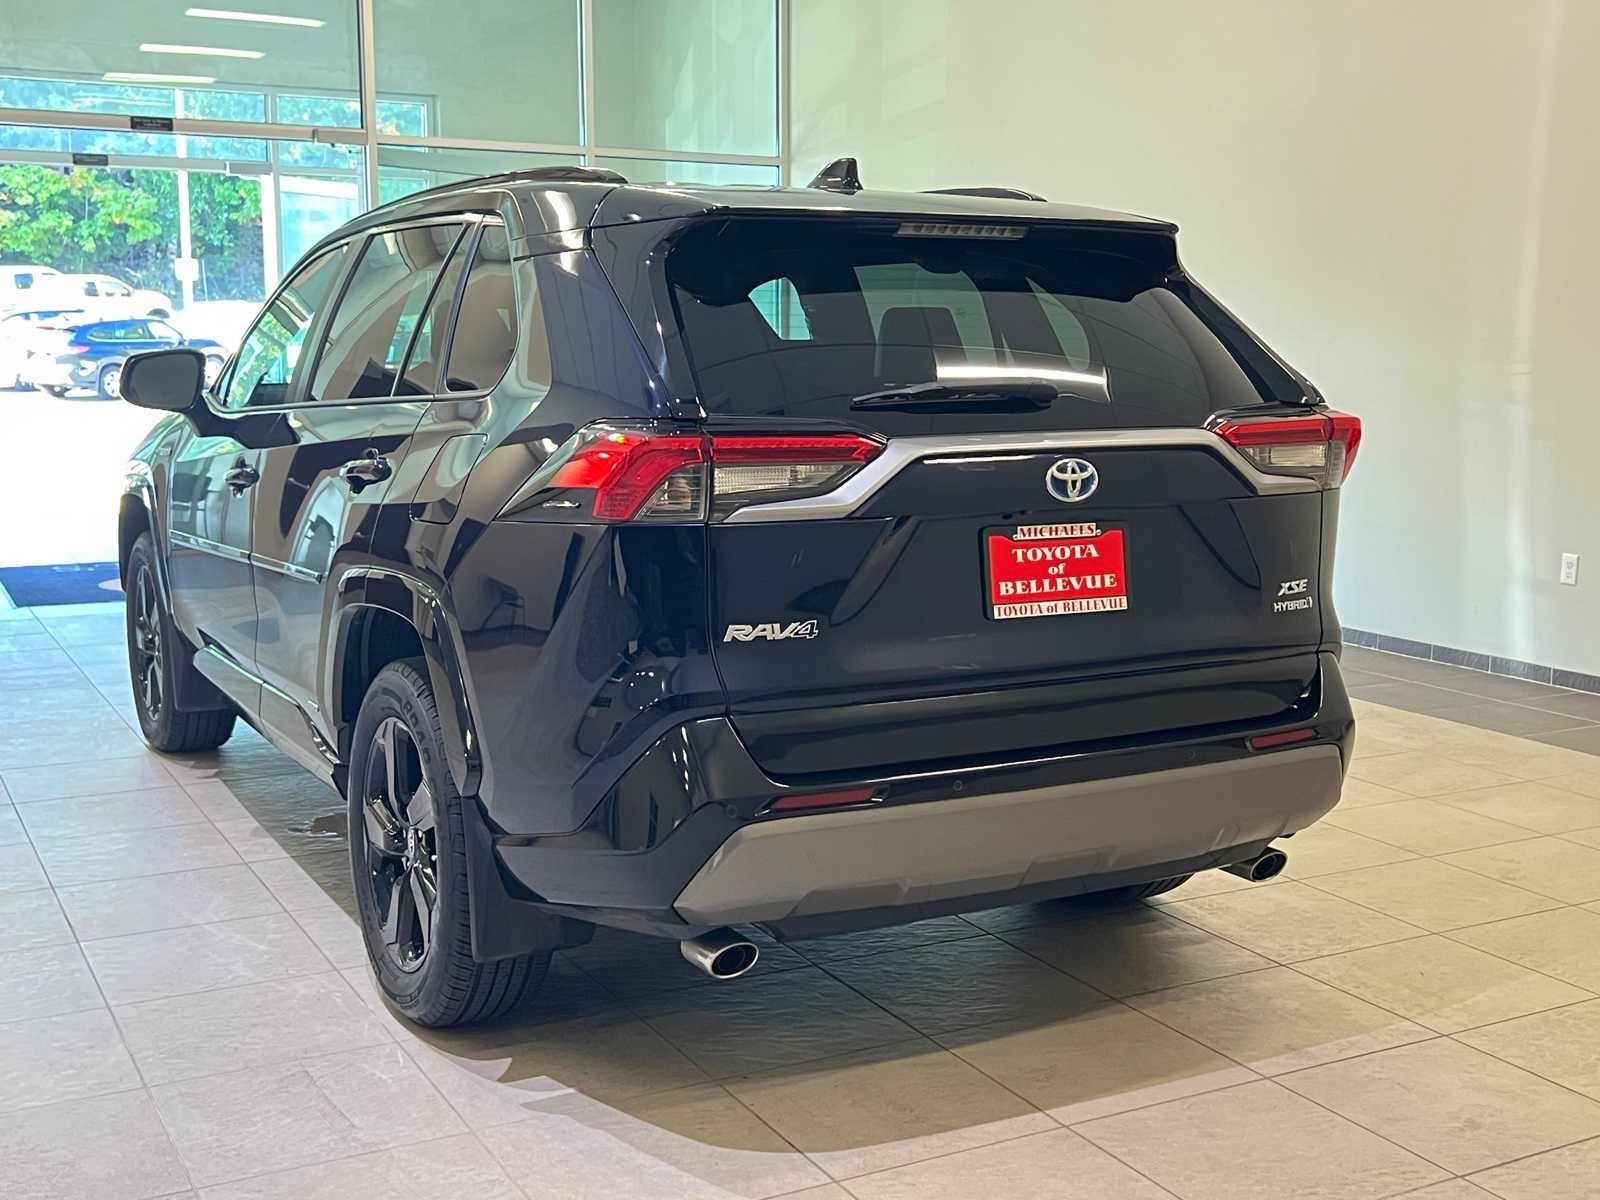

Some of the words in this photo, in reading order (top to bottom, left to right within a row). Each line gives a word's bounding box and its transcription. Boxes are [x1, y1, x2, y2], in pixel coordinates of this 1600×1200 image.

[1018, 524, 1095, 538] MICHAELS
[1012, 544, 1099, 563] TOYOTA
[1048, 563, 1067, 575] of
[999, 573, 1117, 596] BELLEVUE
[1278, 578, 1308, 597] XSE
[996, 603, 1043, 618] TOYOTA
[1046, 603, 1059, 614] of
[1063, 598, 1125, 613] BELLEVUE
[1273, 596, 1313, 613] HYBRID
[723, 619, 819, 642] RAV4
